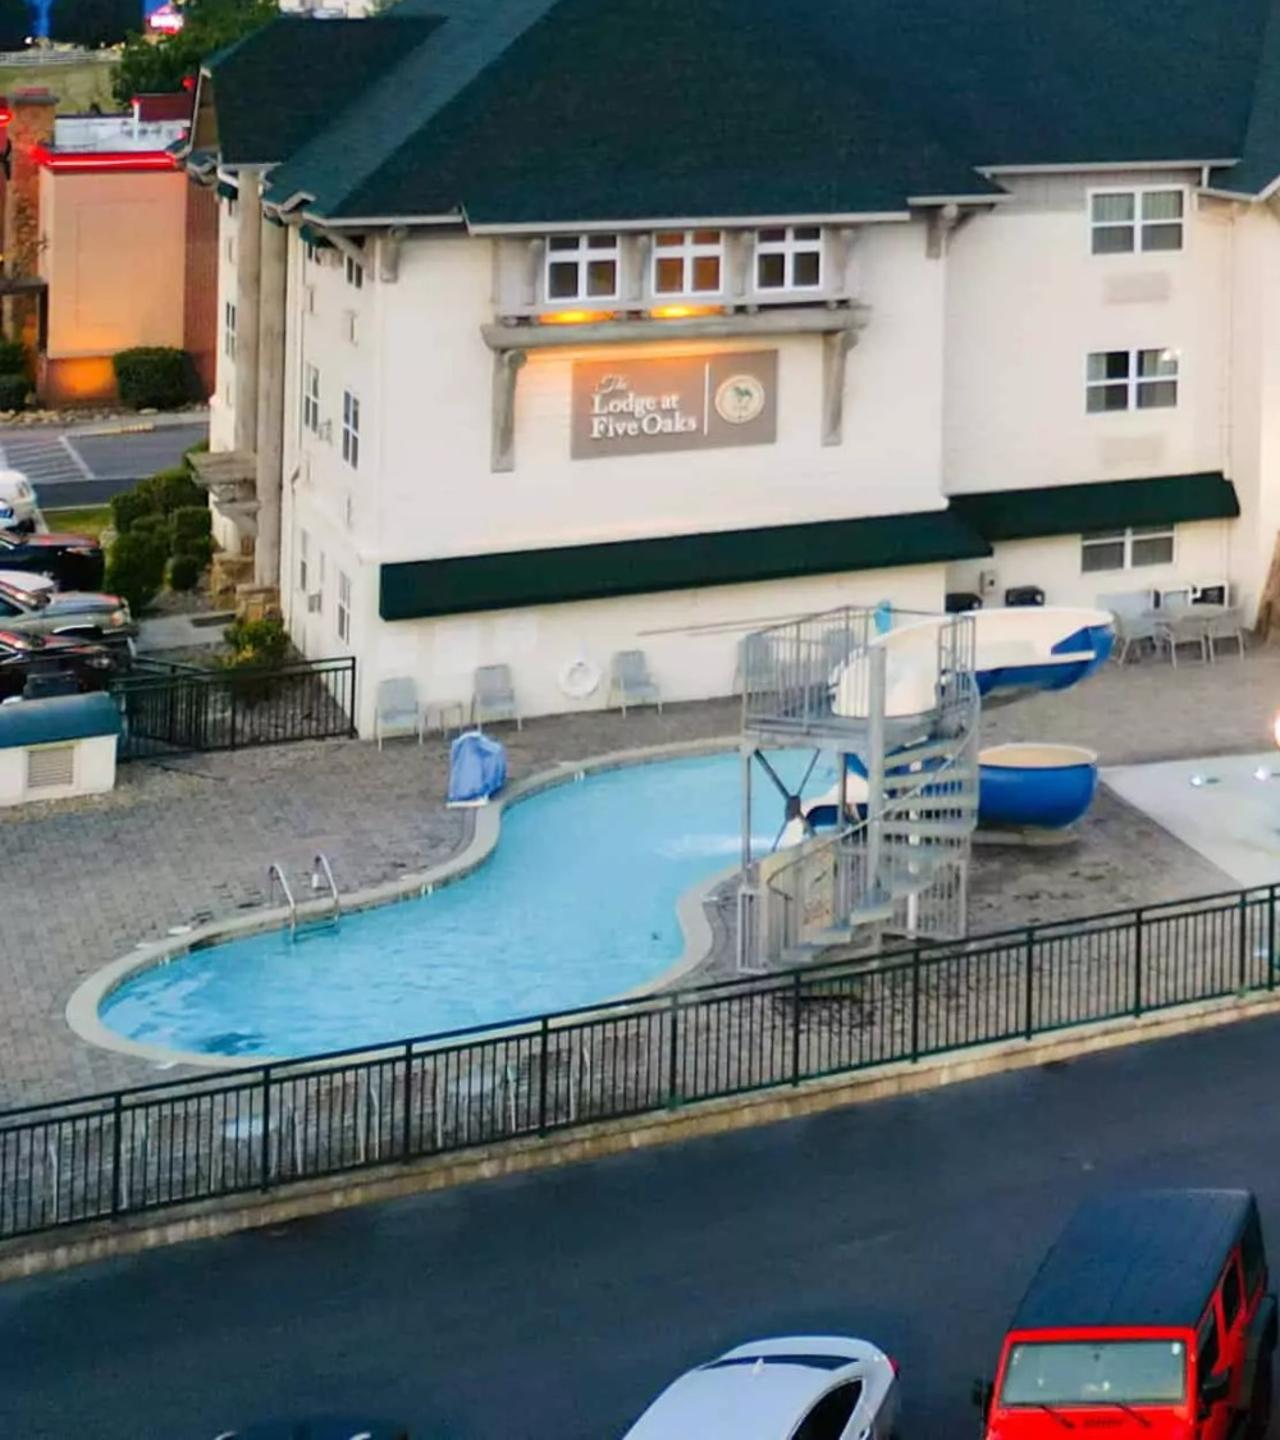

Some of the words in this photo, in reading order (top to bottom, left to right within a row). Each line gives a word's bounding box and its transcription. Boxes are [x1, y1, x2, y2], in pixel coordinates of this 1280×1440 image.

[592, 392, 656, 418] Lodge
[661, 394, 680, 410] at
[590, 415, 639, 438] Five
[642, 411, 697, 435] Oaks
